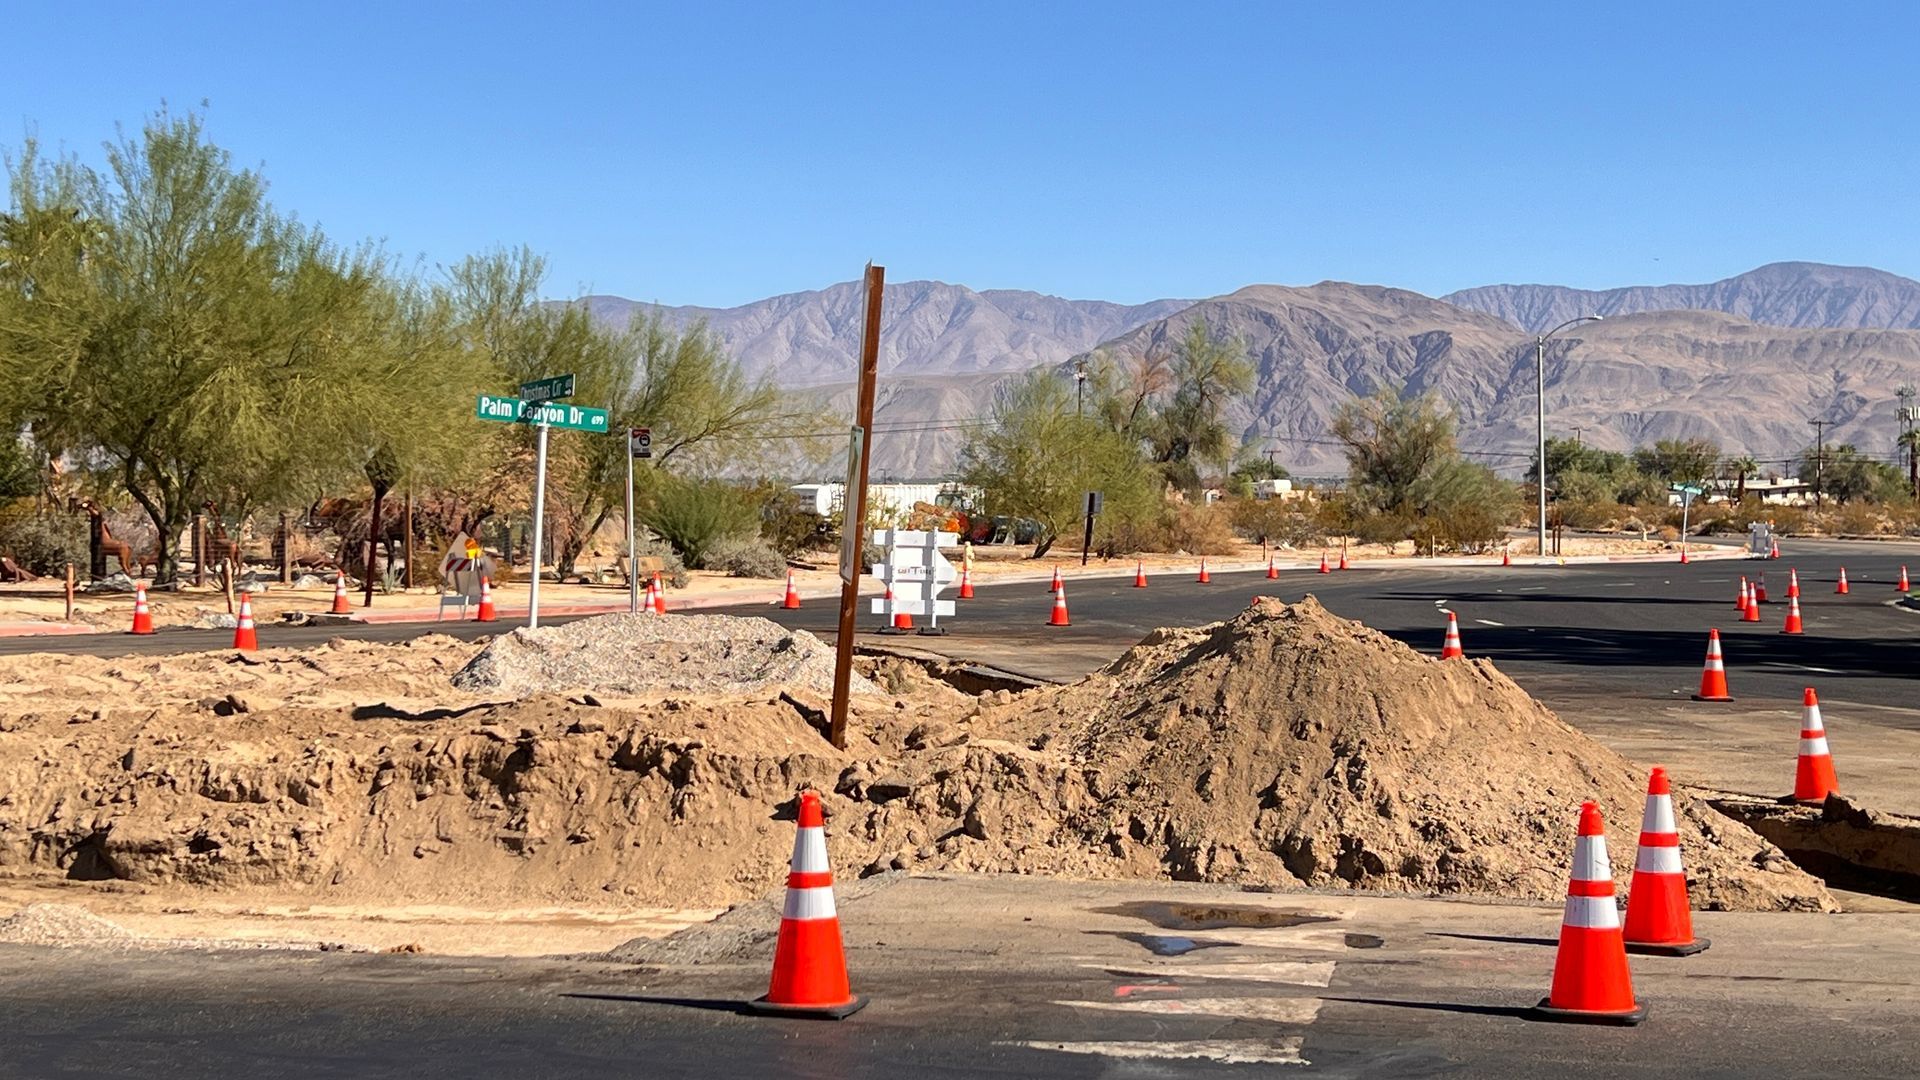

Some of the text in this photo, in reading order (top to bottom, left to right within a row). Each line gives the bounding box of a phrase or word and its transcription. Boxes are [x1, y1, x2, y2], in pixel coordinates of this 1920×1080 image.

[520, 385, 551, 401] Christmas
[481, 397, 513, 417] Palm
[517, 401, 565, 423] Canyon
[570, 407, 584, 425] Dr
